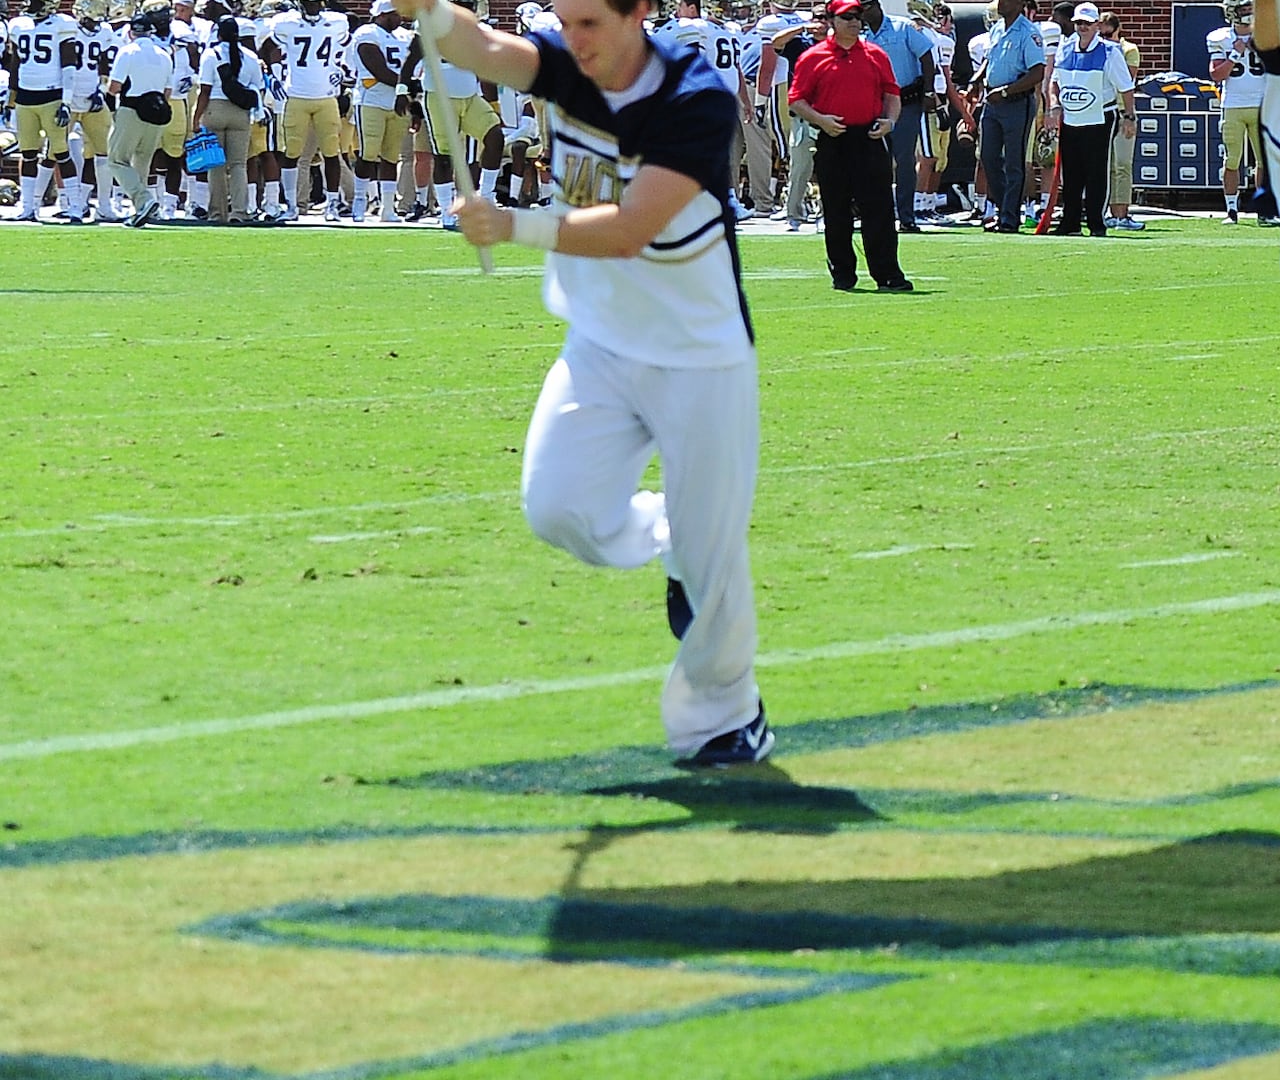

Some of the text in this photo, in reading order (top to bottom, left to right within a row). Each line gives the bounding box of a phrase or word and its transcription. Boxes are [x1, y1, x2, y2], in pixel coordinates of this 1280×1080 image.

[18, 34, 53, 65] 95
[294, 36, 333, 68] 74
[1062, 91, 1088, 101] ACC
